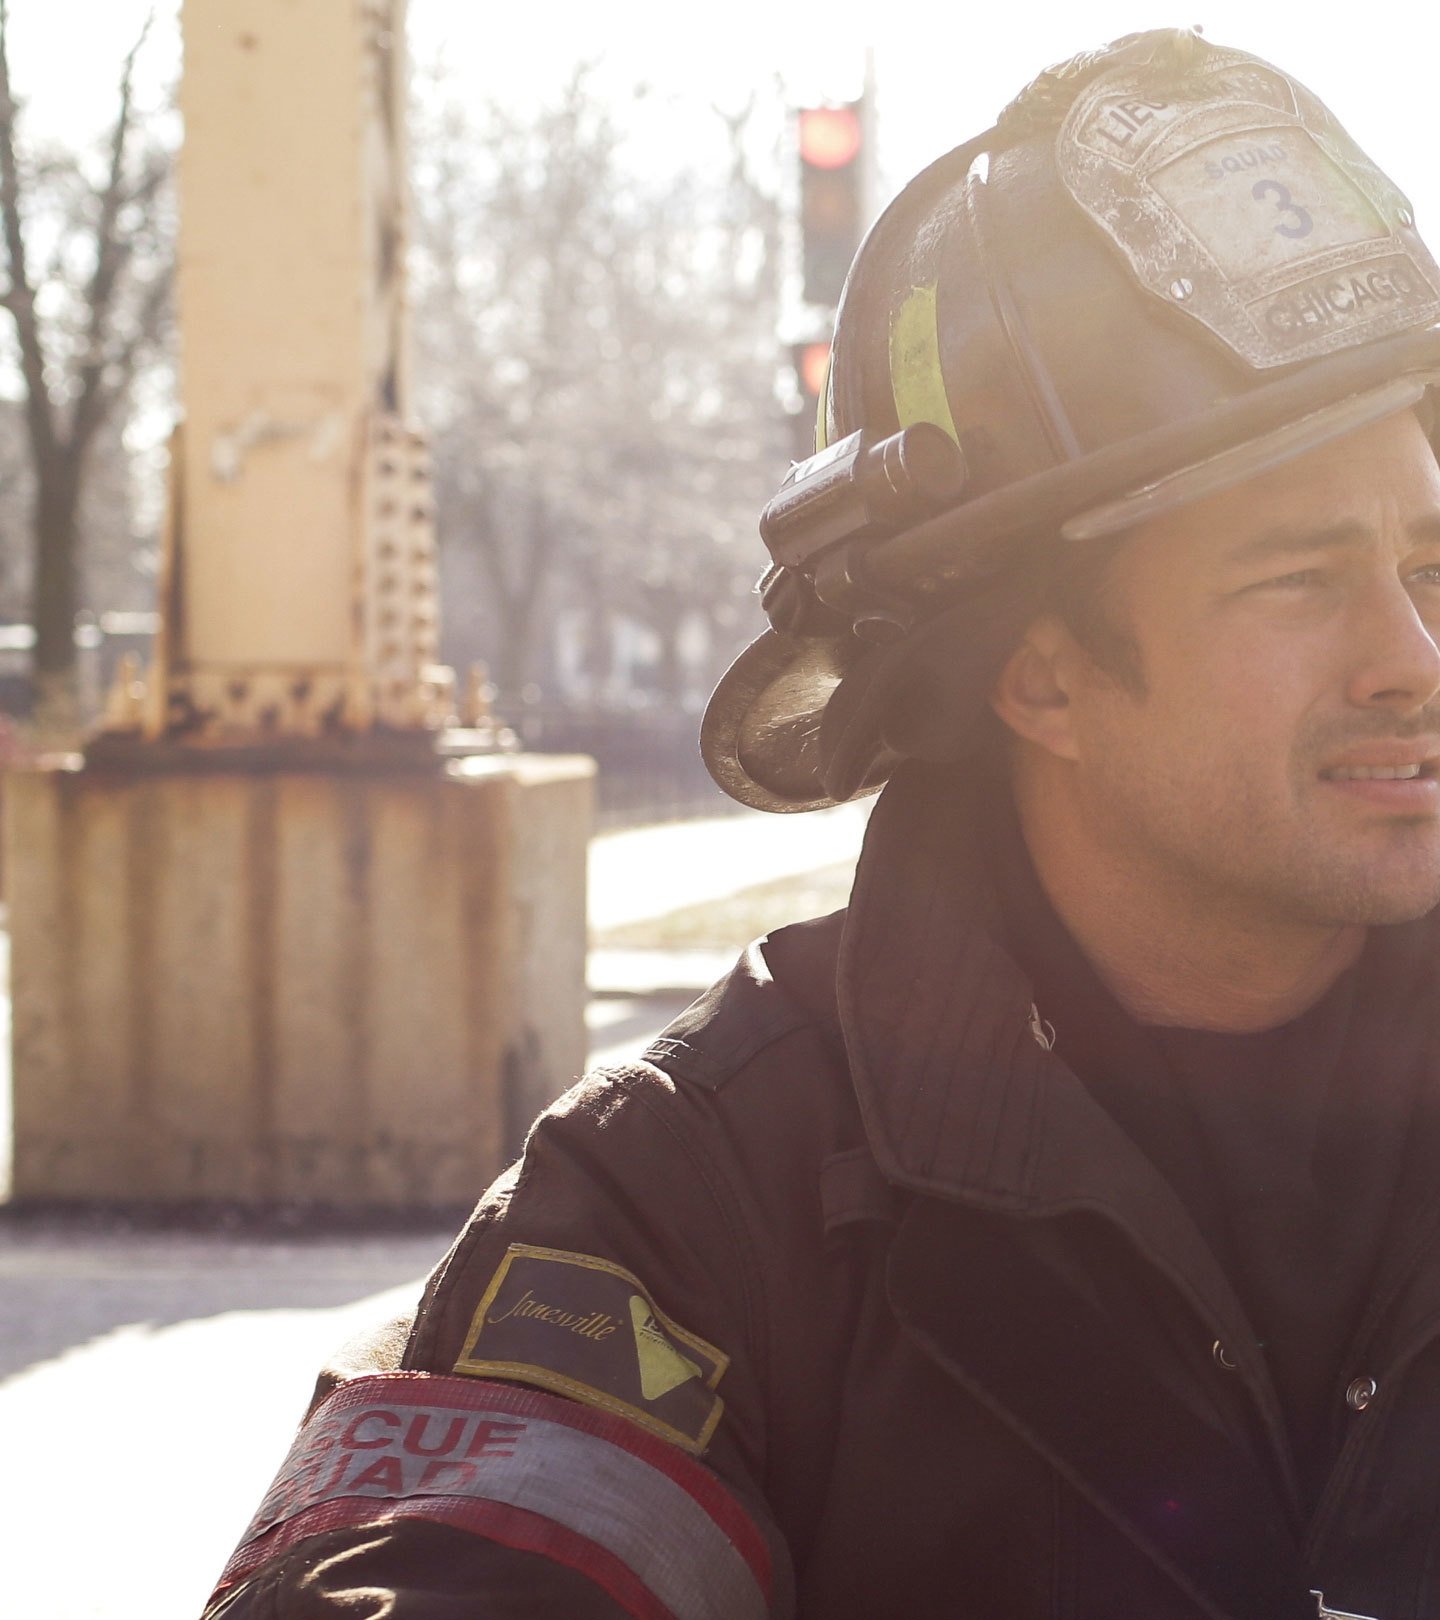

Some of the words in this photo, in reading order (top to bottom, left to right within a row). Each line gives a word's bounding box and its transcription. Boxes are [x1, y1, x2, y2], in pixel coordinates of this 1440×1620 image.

[1204, 144, 1289, 180] SQUAD
[1252, 179, 1313, 239] 3
[1265, 267, 1416, 334] CHICAGO
[488, 1290, 617, 1341] Janesville
